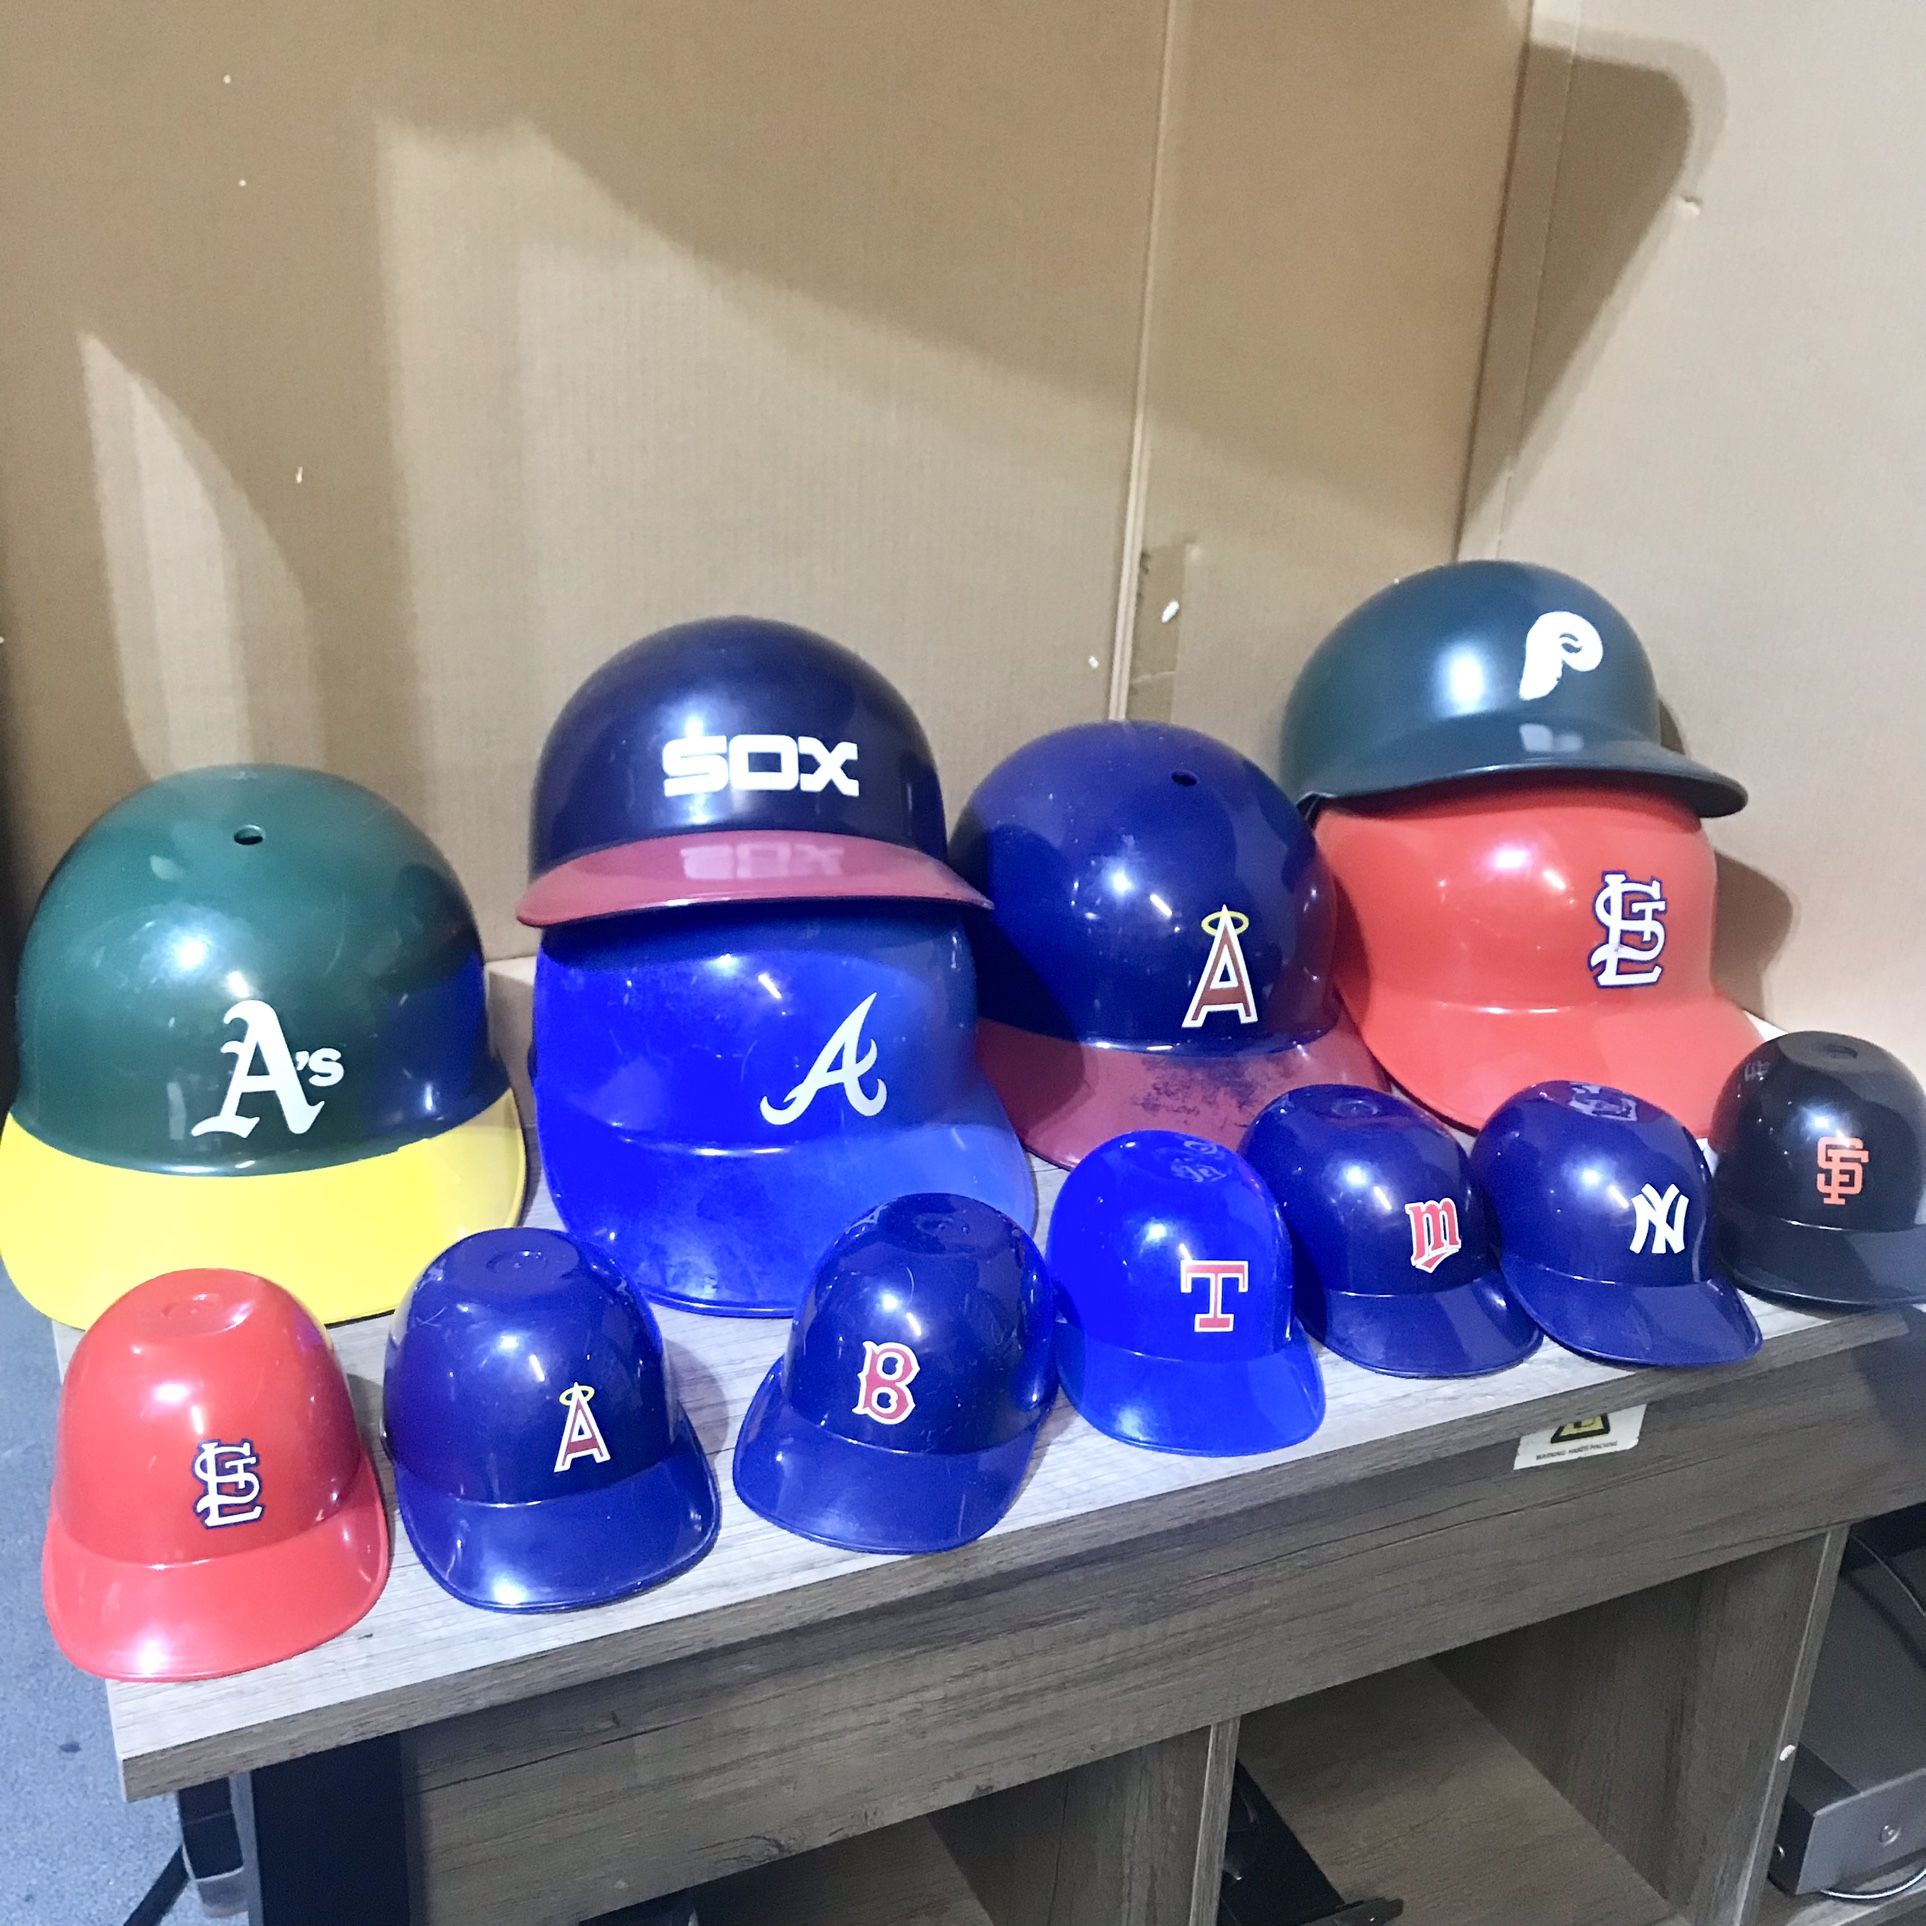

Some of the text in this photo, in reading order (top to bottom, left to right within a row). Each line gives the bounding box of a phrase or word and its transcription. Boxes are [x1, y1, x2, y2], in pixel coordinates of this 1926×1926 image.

[1519, 611, 1604, 701] P
[661, 733, 860, 798] SOX
[1181, 904, 1259, 1029] A
[191, 999, 345, 1139] A's
[759, 991, 888, 1126] A
[1629, 1183, 1690, 1255] NY
[1179, 1259, 1249, 1334] T
[553, 1381, 611, 1473] A
[852, 1341, 921, 1426] B
